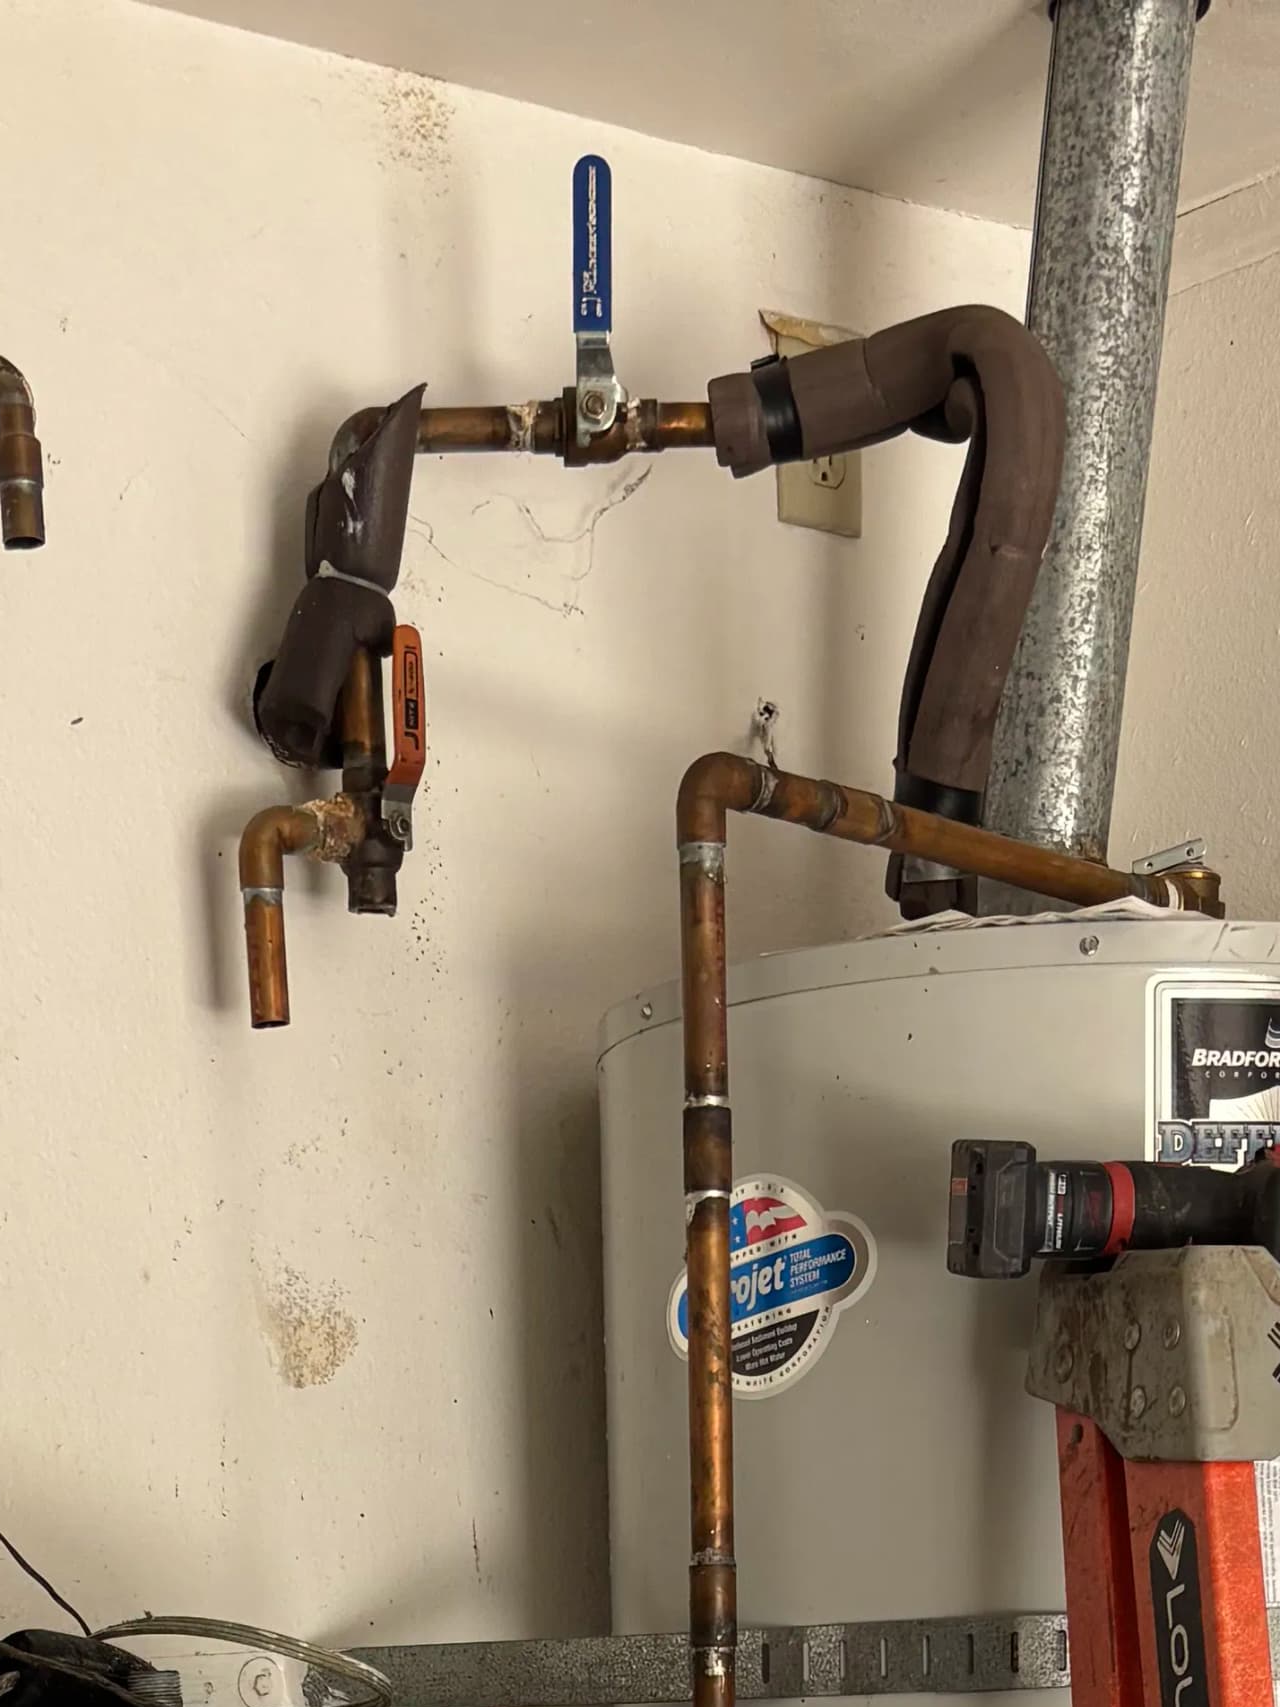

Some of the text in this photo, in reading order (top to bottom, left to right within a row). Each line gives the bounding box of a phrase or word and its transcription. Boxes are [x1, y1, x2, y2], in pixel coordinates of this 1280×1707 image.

[790, 1248, 811, 1263] TOTAL
[790, 1249, 846, 1276] PERFORMANCE
[790, 1270, 820, 1288] SYSTEM
